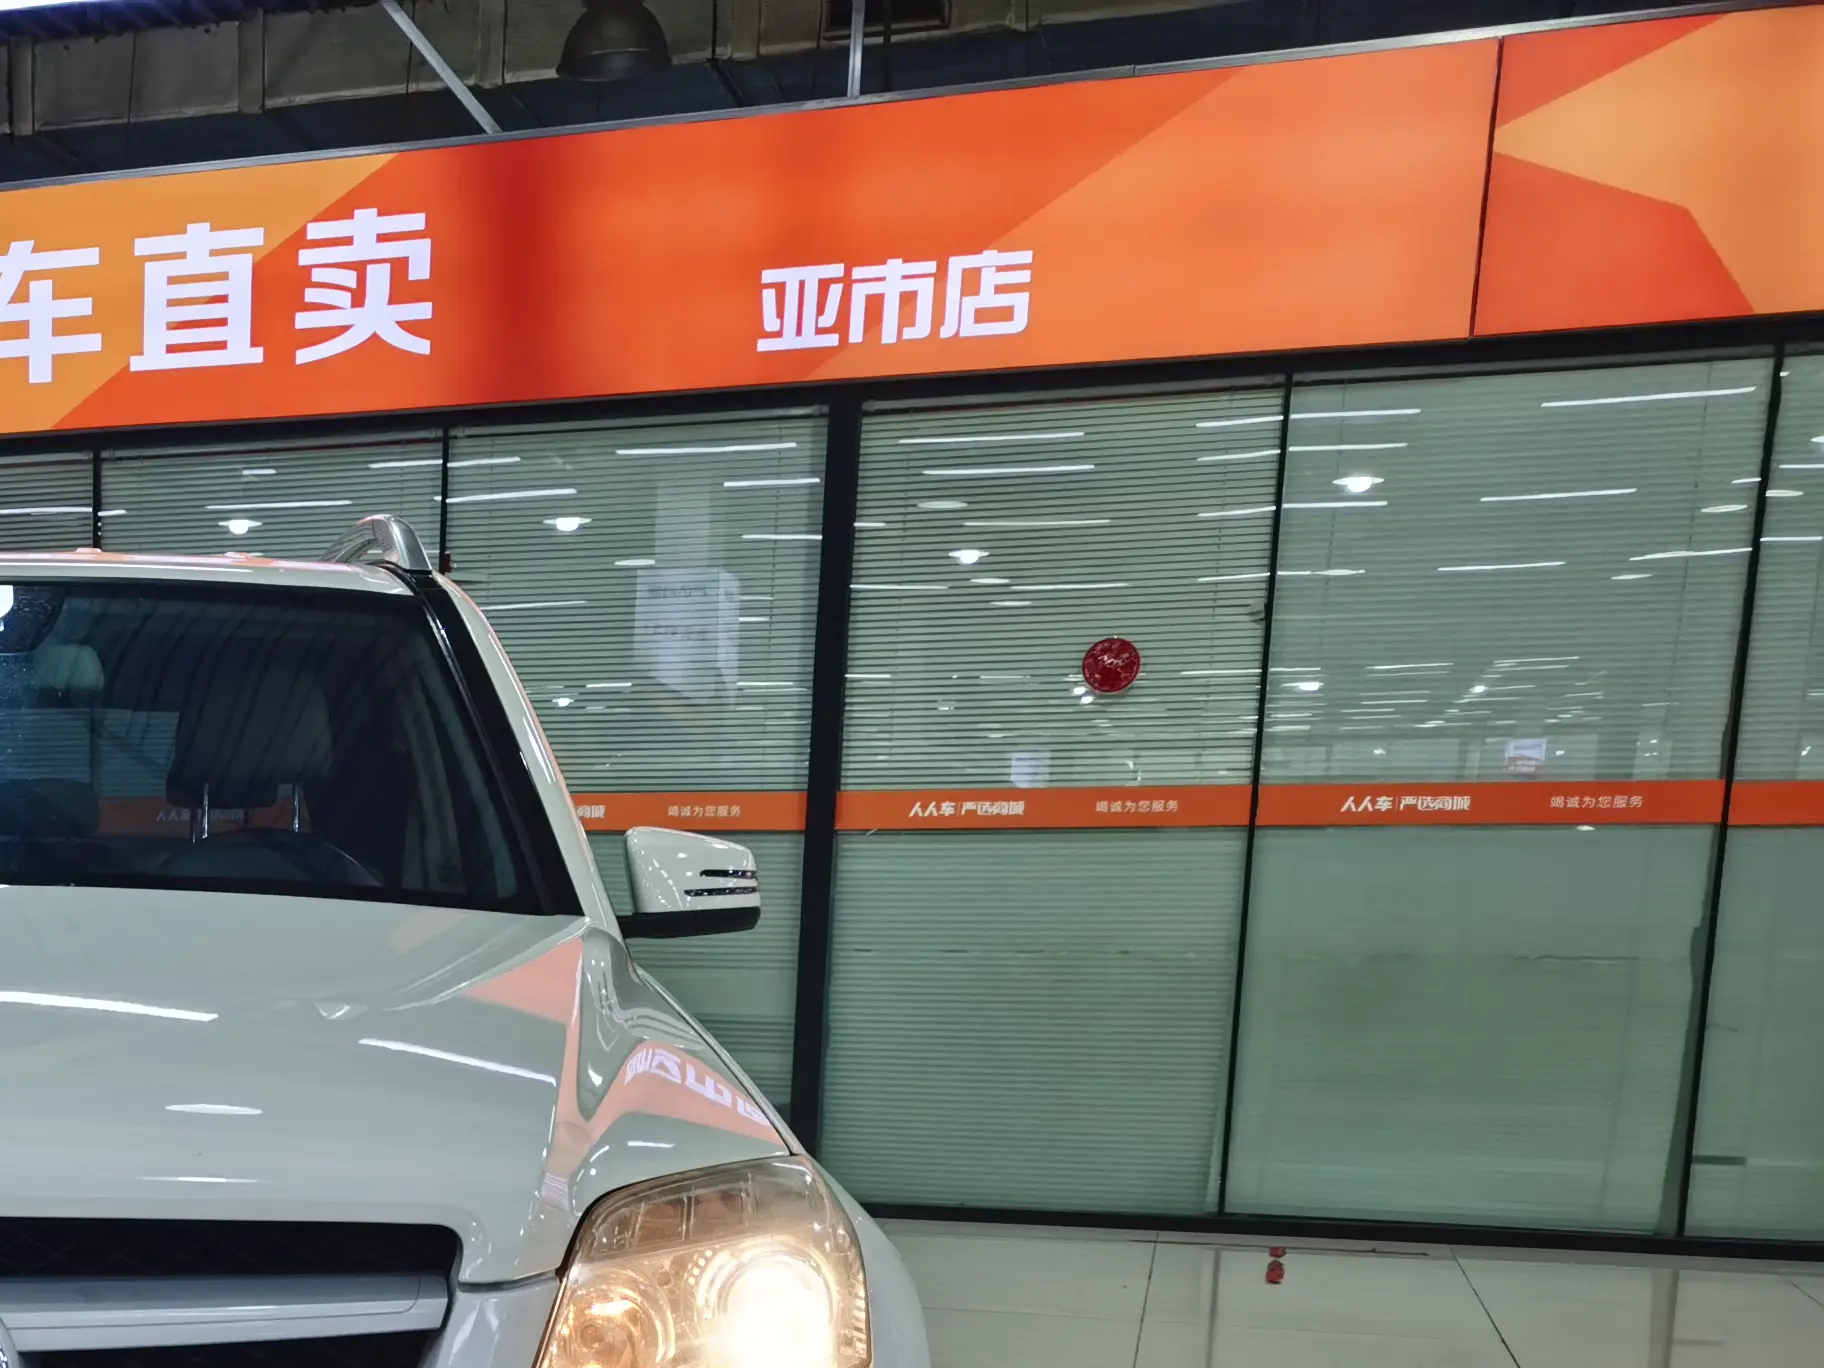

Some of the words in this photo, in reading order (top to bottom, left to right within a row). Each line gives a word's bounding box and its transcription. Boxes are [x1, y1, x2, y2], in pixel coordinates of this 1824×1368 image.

[757, 249, 1033, 352] 亚市店
[909, 801, 956, 817] 人人车
[961, 801, 1025, 816] 严选商城
[1095, 799, 1179, 813] 竭诚为您服务
[1340, 796, 1393, 812] 人人车
[1399, 795, 1471, 811] 严选商城
[1550, 796, 1643, 809] 竭诚为您服务
